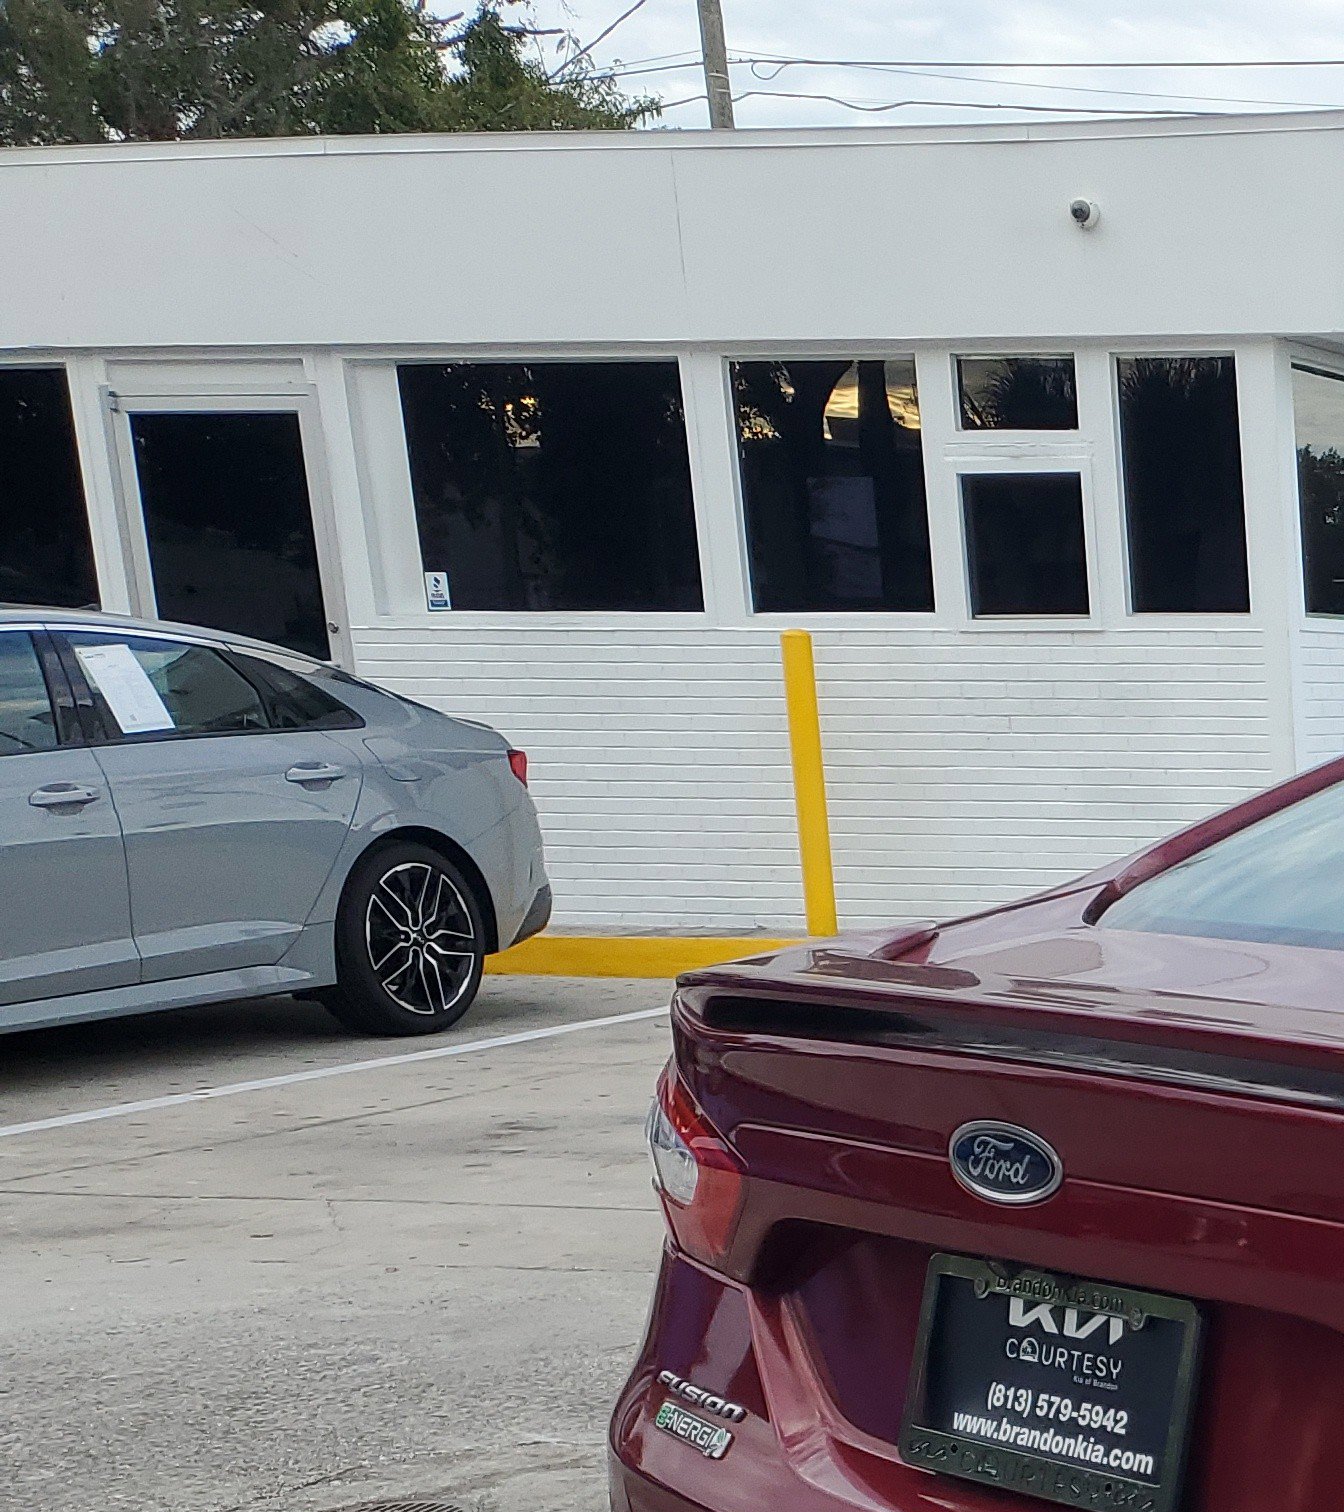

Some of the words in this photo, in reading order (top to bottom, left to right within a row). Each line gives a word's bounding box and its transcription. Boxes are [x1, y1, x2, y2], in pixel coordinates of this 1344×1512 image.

[968, 1136, 1030, 1185] Ford
[1009, 1296, 1124, 1347] KIA
[1006, 1337, 1122, 1380] COURTESY
[987, 1381, 1033, 1418] (813)
[1035, 1394, 1129, 1436] 579-5942
[952, 1411, 1155, 1476] www.brandonkia.com
